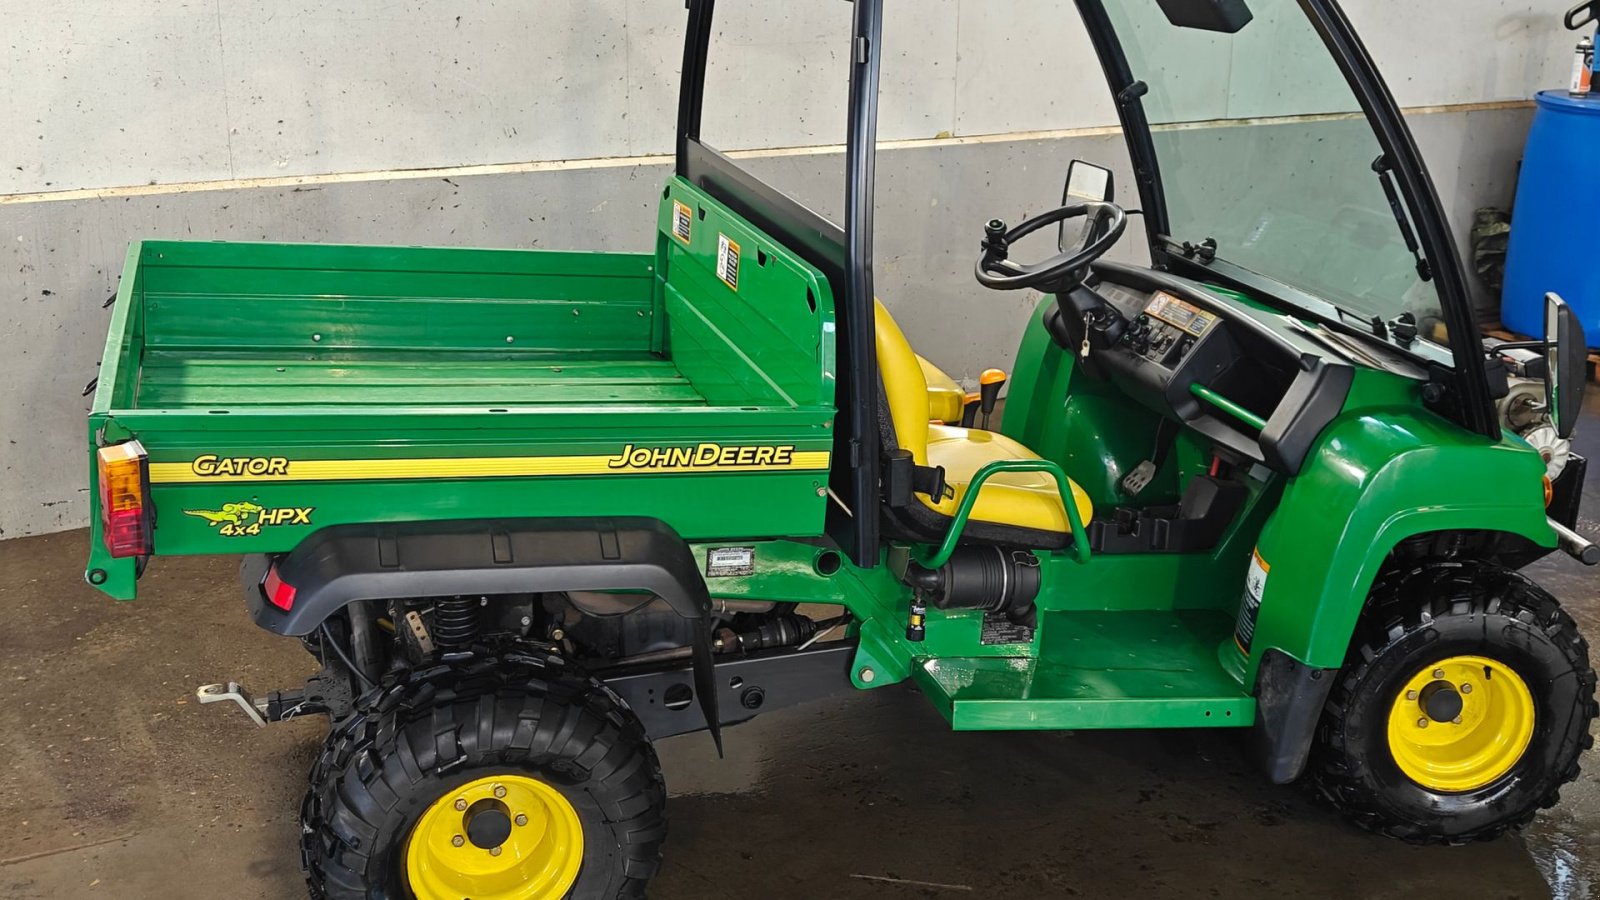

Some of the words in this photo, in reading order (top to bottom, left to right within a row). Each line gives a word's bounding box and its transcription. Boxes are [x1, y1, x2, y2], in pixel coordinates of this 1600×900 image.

[192, 454, 288, 475] GATOR
[608, 444, 693, 468] JOHN
[693, 443, 795, 466] DEERE
[258, 507, 315, 524] HPX
[219, 523, 261, 536] 4x4
